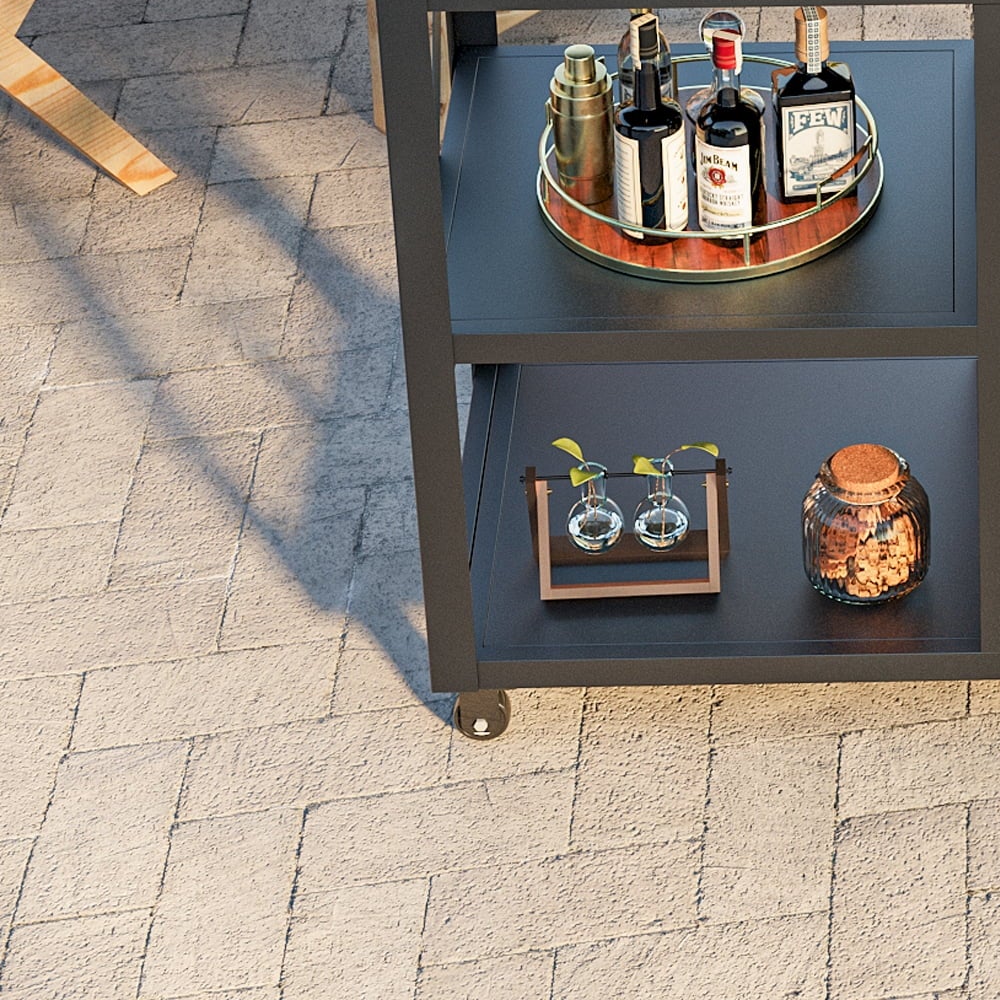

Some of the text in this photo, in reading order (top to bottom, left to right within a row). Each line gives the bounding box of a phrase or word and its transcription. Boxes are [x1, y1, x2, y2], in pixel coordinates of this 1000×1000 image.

[791, 106, 844, 134] FEW
[701, 152, 738, 171] JIM BEAM
